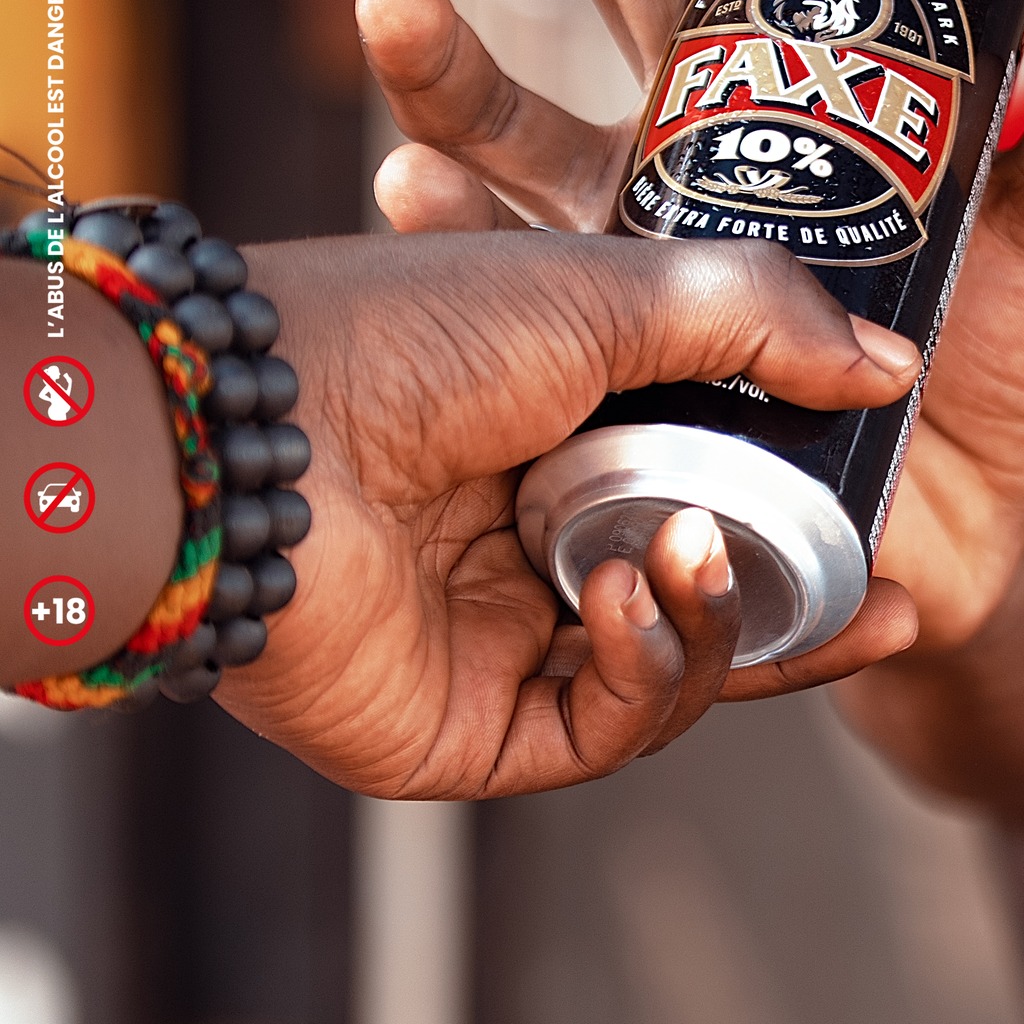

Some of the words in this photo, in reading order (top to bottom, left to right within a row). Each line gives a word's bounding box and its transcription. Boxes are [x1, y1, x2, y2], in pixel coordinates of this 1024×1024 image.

[893, 21, 924, 46] 1901
[655, 37, 940, 174] FAXE
[710, 126, 835, 178] 10%
[654, 201, 711, 230] EXTRA
[716, 216, 790, 242] FORTE
[801, 226, 829, 245] DE
[836, 208, 907, 246] QUALITÉ
